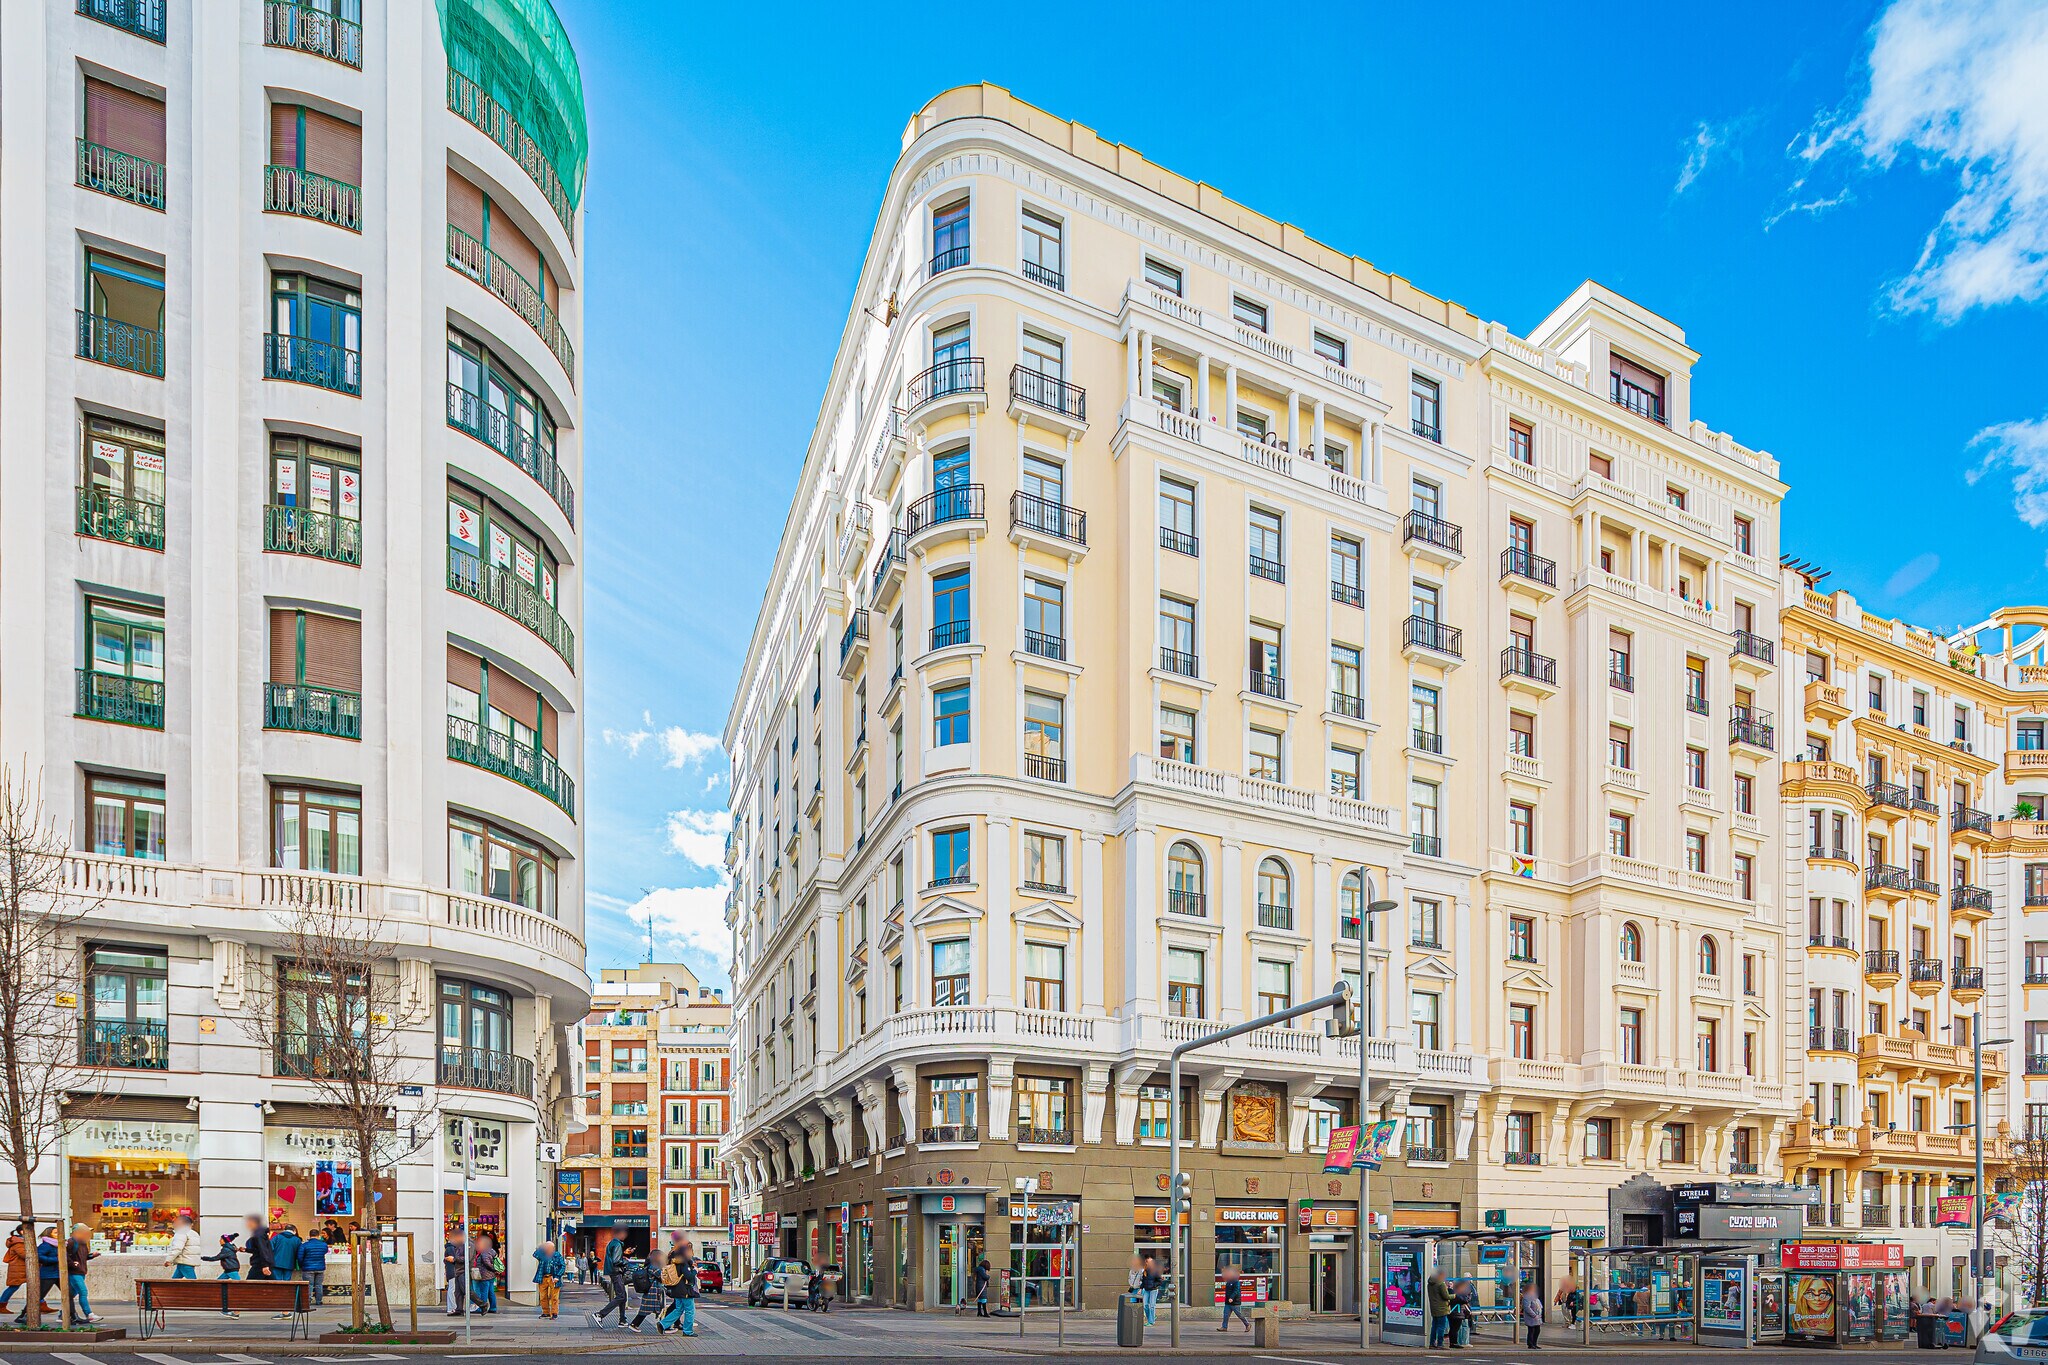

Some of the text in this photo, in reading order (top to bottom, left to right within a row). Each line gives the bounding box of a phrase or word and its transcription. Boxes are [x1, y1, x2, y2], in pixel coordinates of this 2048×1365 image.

[136, 460, 163, 470] ALGERIE
[84, 1126, 195, 1144] flying tiger
[449, 1119, 502, 1145] fling
[1332, 1129, 1355, 1138] FELIZ
[285, 1133, 336, 1149] flying
[1329, 1141, 1351, 1151] CHINO
[107, 1144, 172, 1152] copenhagen
[107, 1181, 149, 1192] No hay
[103, 1190, 154, 1199] amor sin
[1941, 1205, 1967, 1213] CHINO
[1223, 1211, 1279, 1220] BURGER KING
[1729, 1215, 1778, 1228] CUZCO LUPITA
[1570, 1227, 1606, 1238] L'ANGÉLYS
[1844, 1247, 1860, 1257] TOURS
[1888, 1247, 1900, 1260] BUS
[1844, 1258, 1860, 1267] TICKETS
[1404, 1308, 1423, 1317] yoigo
[1793, 1312, 1831, 1322] Buscando
[2023, 1349, 2047, 1357] 9166
